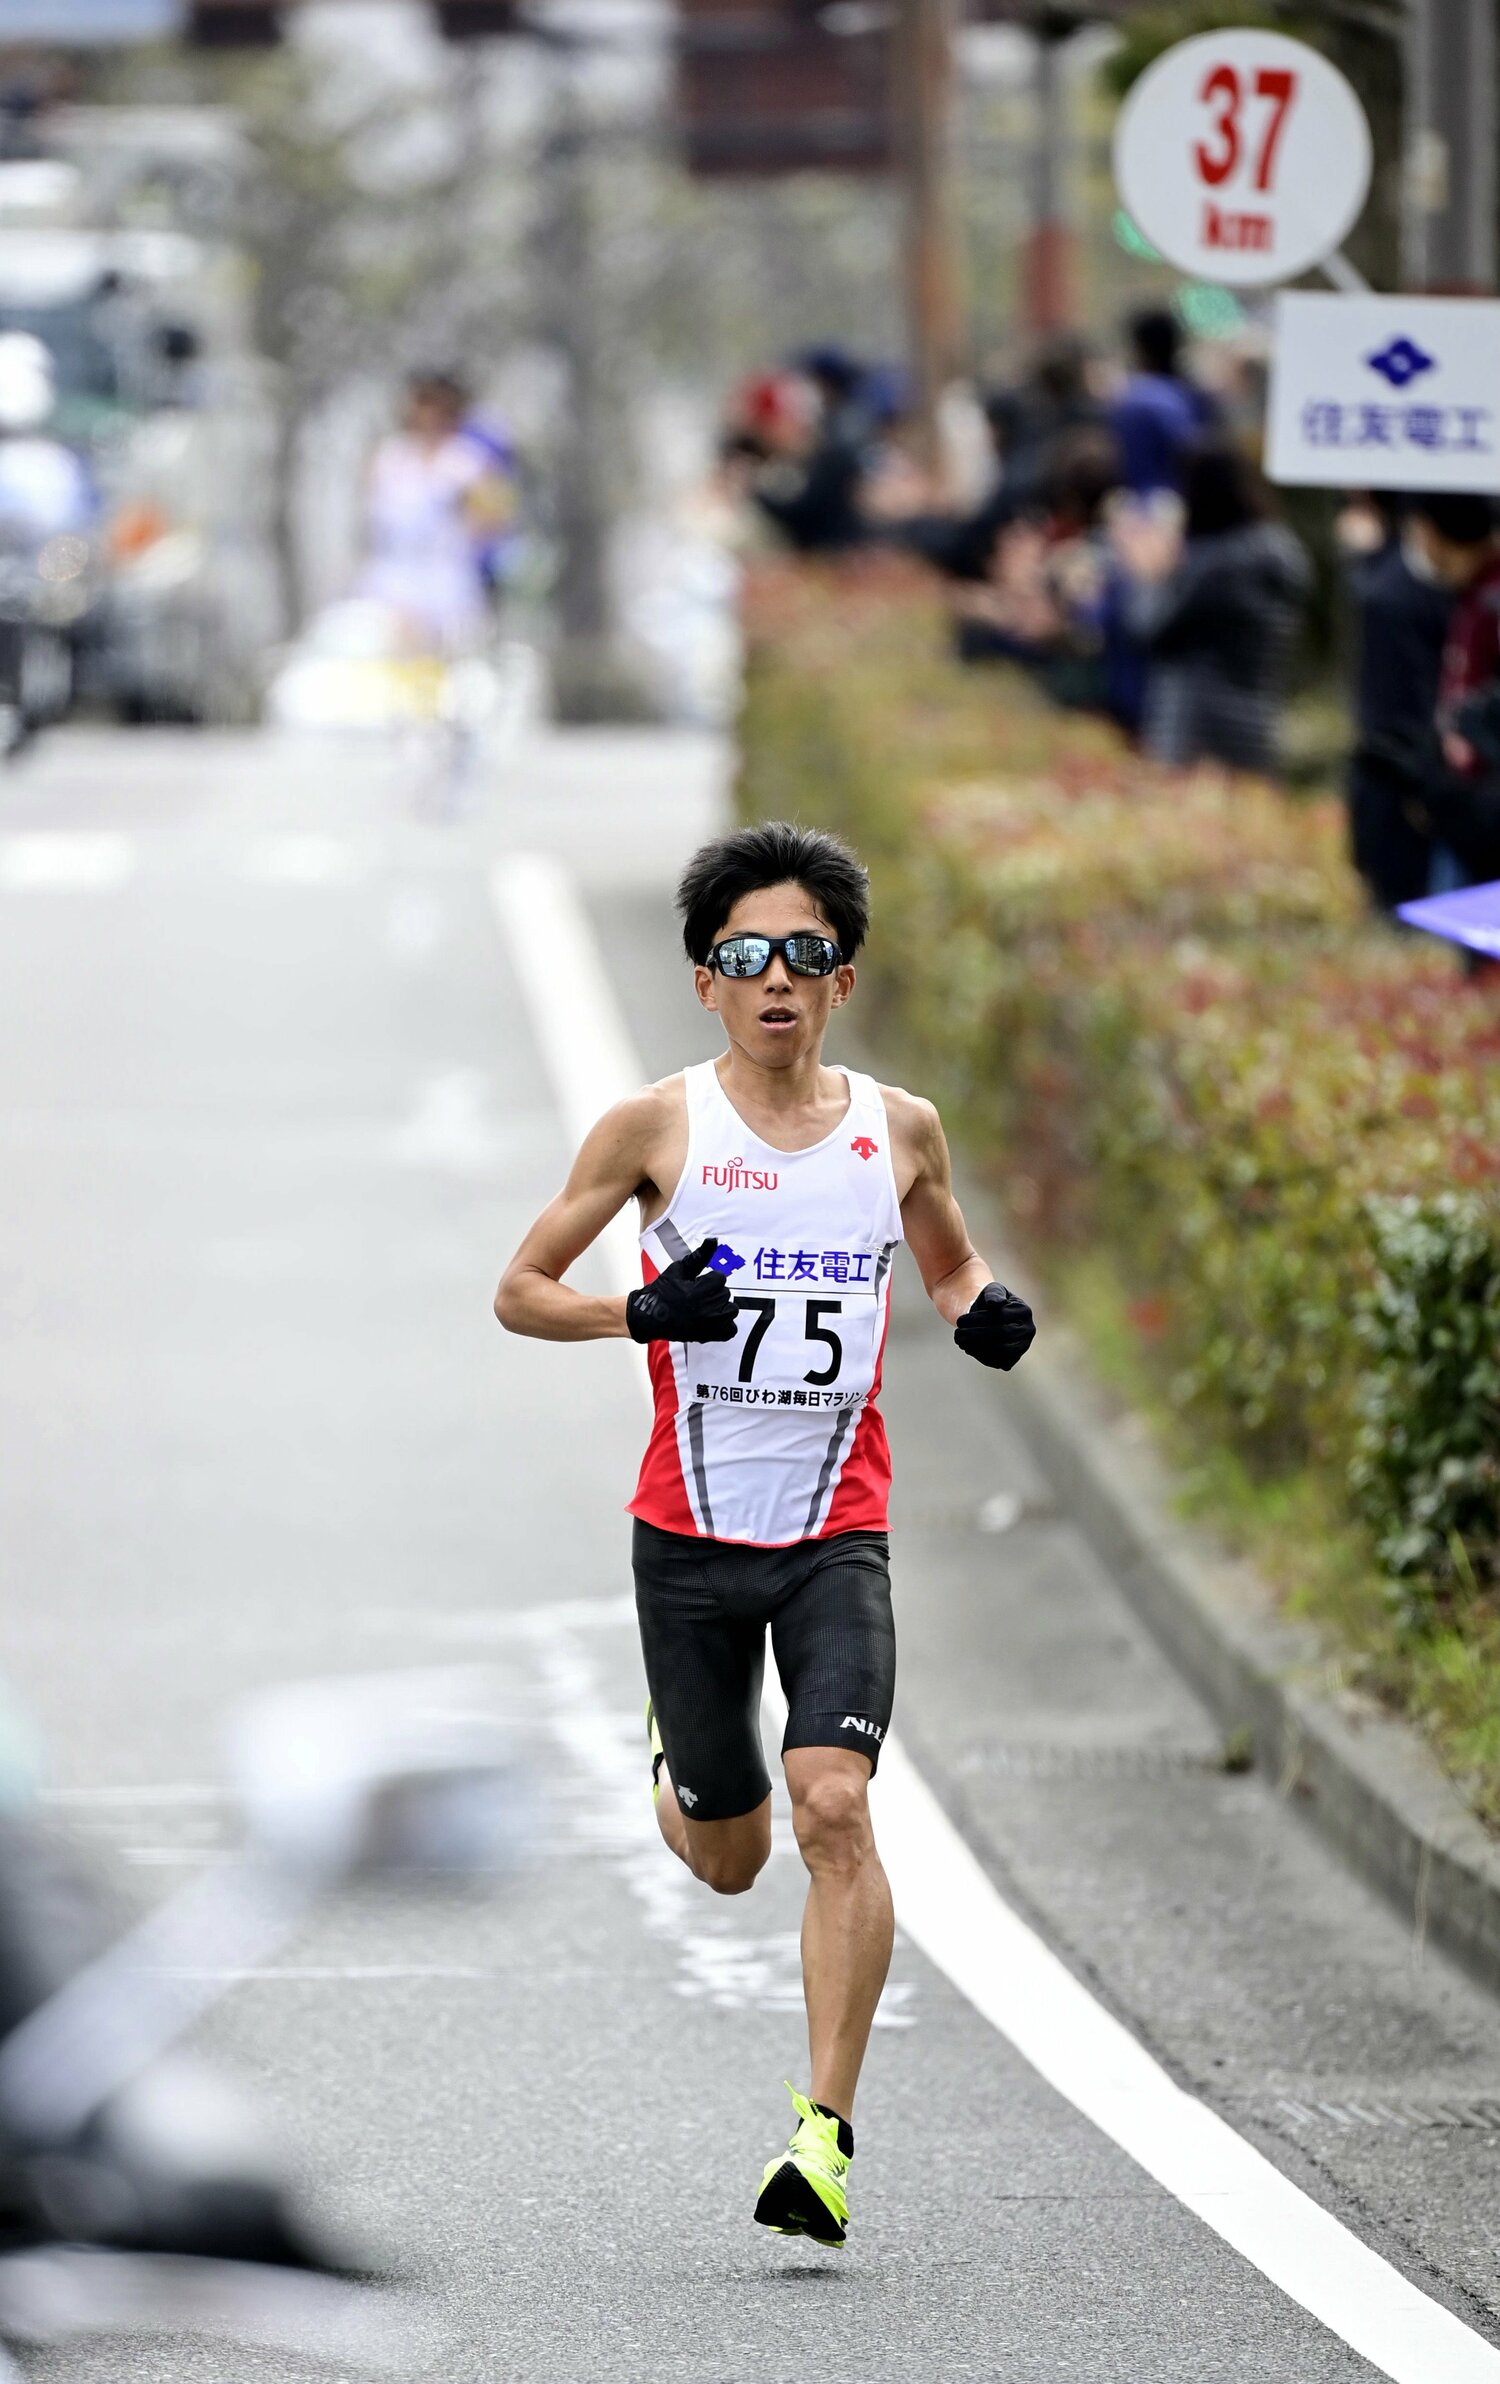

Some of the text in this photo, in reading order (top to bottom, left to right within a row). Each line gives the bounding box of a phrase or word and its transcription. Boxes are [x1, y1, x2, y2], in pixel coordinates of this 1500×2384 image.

[1193, 64, 1296, 191] 37
[1204, 202, 1273, 250] km
[702, 1157, 778, 1194] FUJITSU
[754, 1247, 872, 1283] 住友電工
[732, 1296, 843, 1386] 75
[697, 1384, 866, 1407] 第76回びわ湖毎日マラソン
